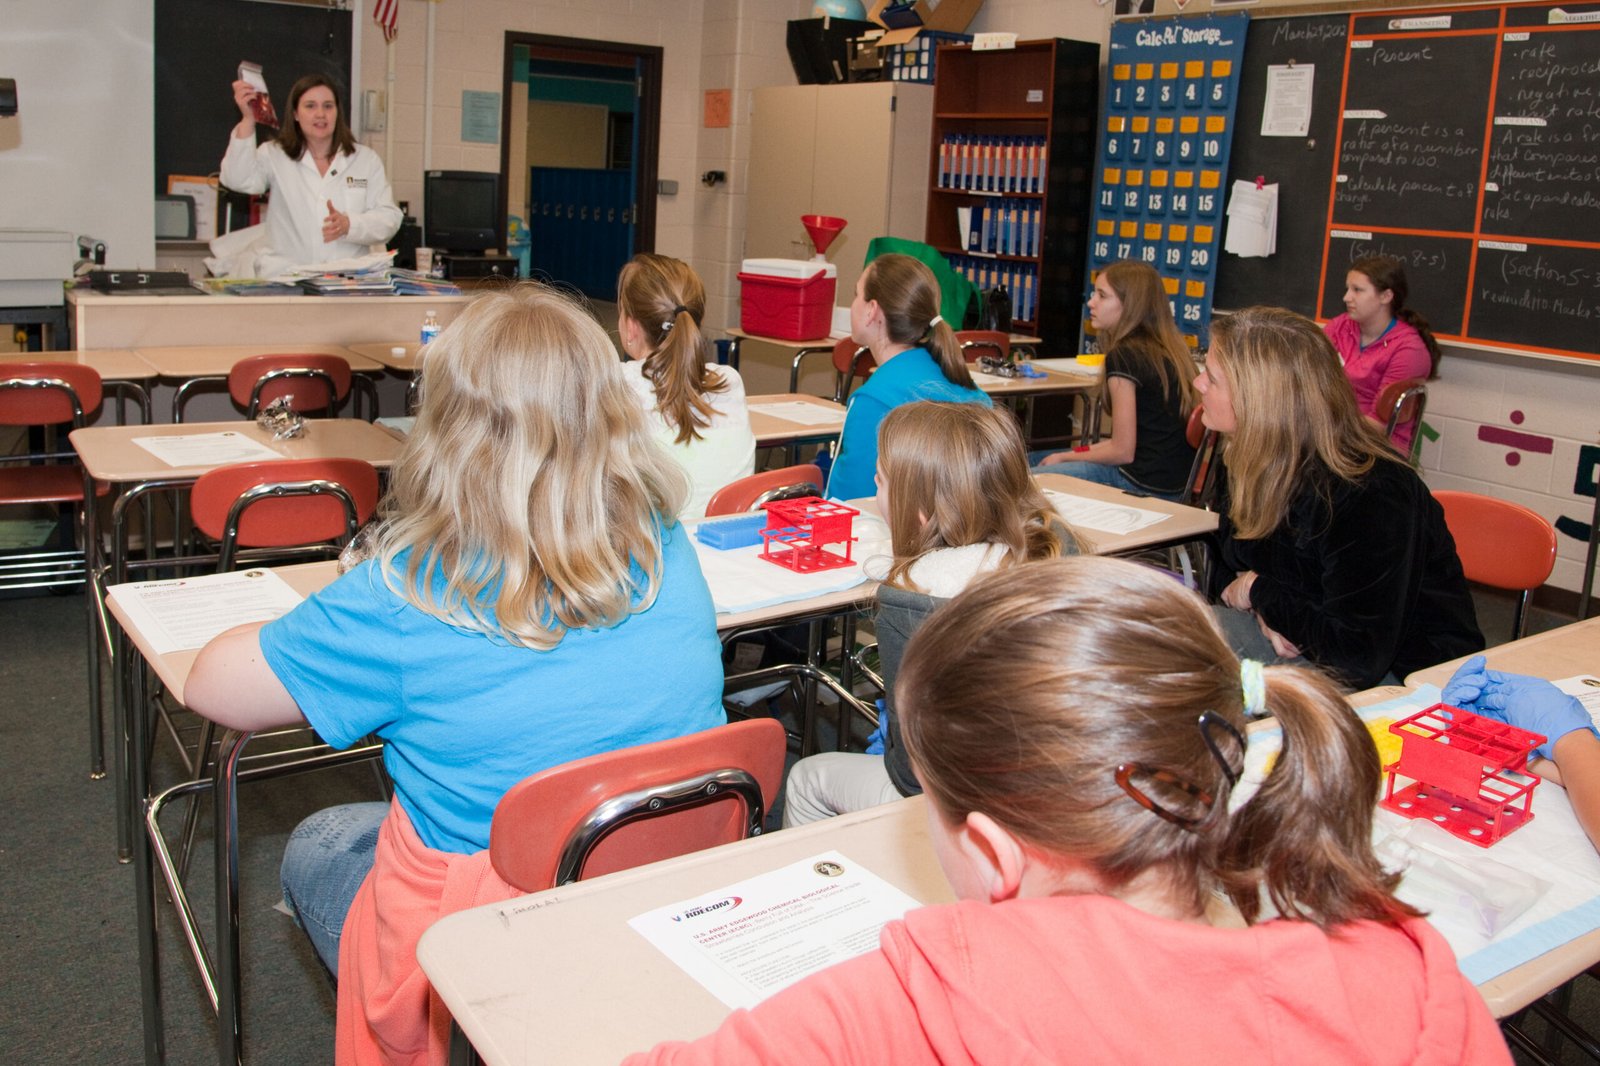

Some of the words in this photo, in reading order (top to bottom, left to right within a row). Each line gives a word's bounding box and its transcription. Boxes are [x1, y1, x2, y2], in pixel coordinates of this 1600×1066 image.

[1182, 28, 1221, 45] Storage
[1115, 88, 1121, 102] 1
[1136, 86, 1145, 102] 2
[1161, 86, 1170, 101] 3
[1186, 84, 1195, 100] 4
[1213, 84, 1222, 100] 5
[1358, 120, 1367, 136] A
[1434, 127, 1448, 138] is
[1455, 127, 1464, 136] a
[1502, 129, 1513, 144] A
[1108, 139, 1117, 154] 6
[1133, 138, 1141, 154] 7
[1156, 141, 1165, 157] 8
[1181, 141, 1190, 157] 9
[1203, 140, 1219, 157] 10
[1101, 190, 1113, 205] 11
[1124, 191, 1137, 207] 12
[1148, 194, 1162, 210] 13
[1172, 195, 1187, 211] 14
[1198, 195, 1213, 211] 15
[1095, 242, 1108, 257] 16
[1118, 243, 1130, 259] 17
[1142, 246, 1155, 261] 18
[1166, 248, 1180, 264] 19
[1191, 249, 1208, 266] 20
[1501, 254, 1567, 285] (Section
[1184, 304, 1200, 320] 25
[1085, 340, 1099, 354] 26
[685, 899, 730, 919] RDECOM
[709, 924, 728, 935] ARMY
[729, 910, 767, 927] EDGEWOOD
[768, 898, 801, 912] CHEMICAL
[802, 884, 840, 900] BIOLOGICAL
[699, 931, 727, 944] CENTER
